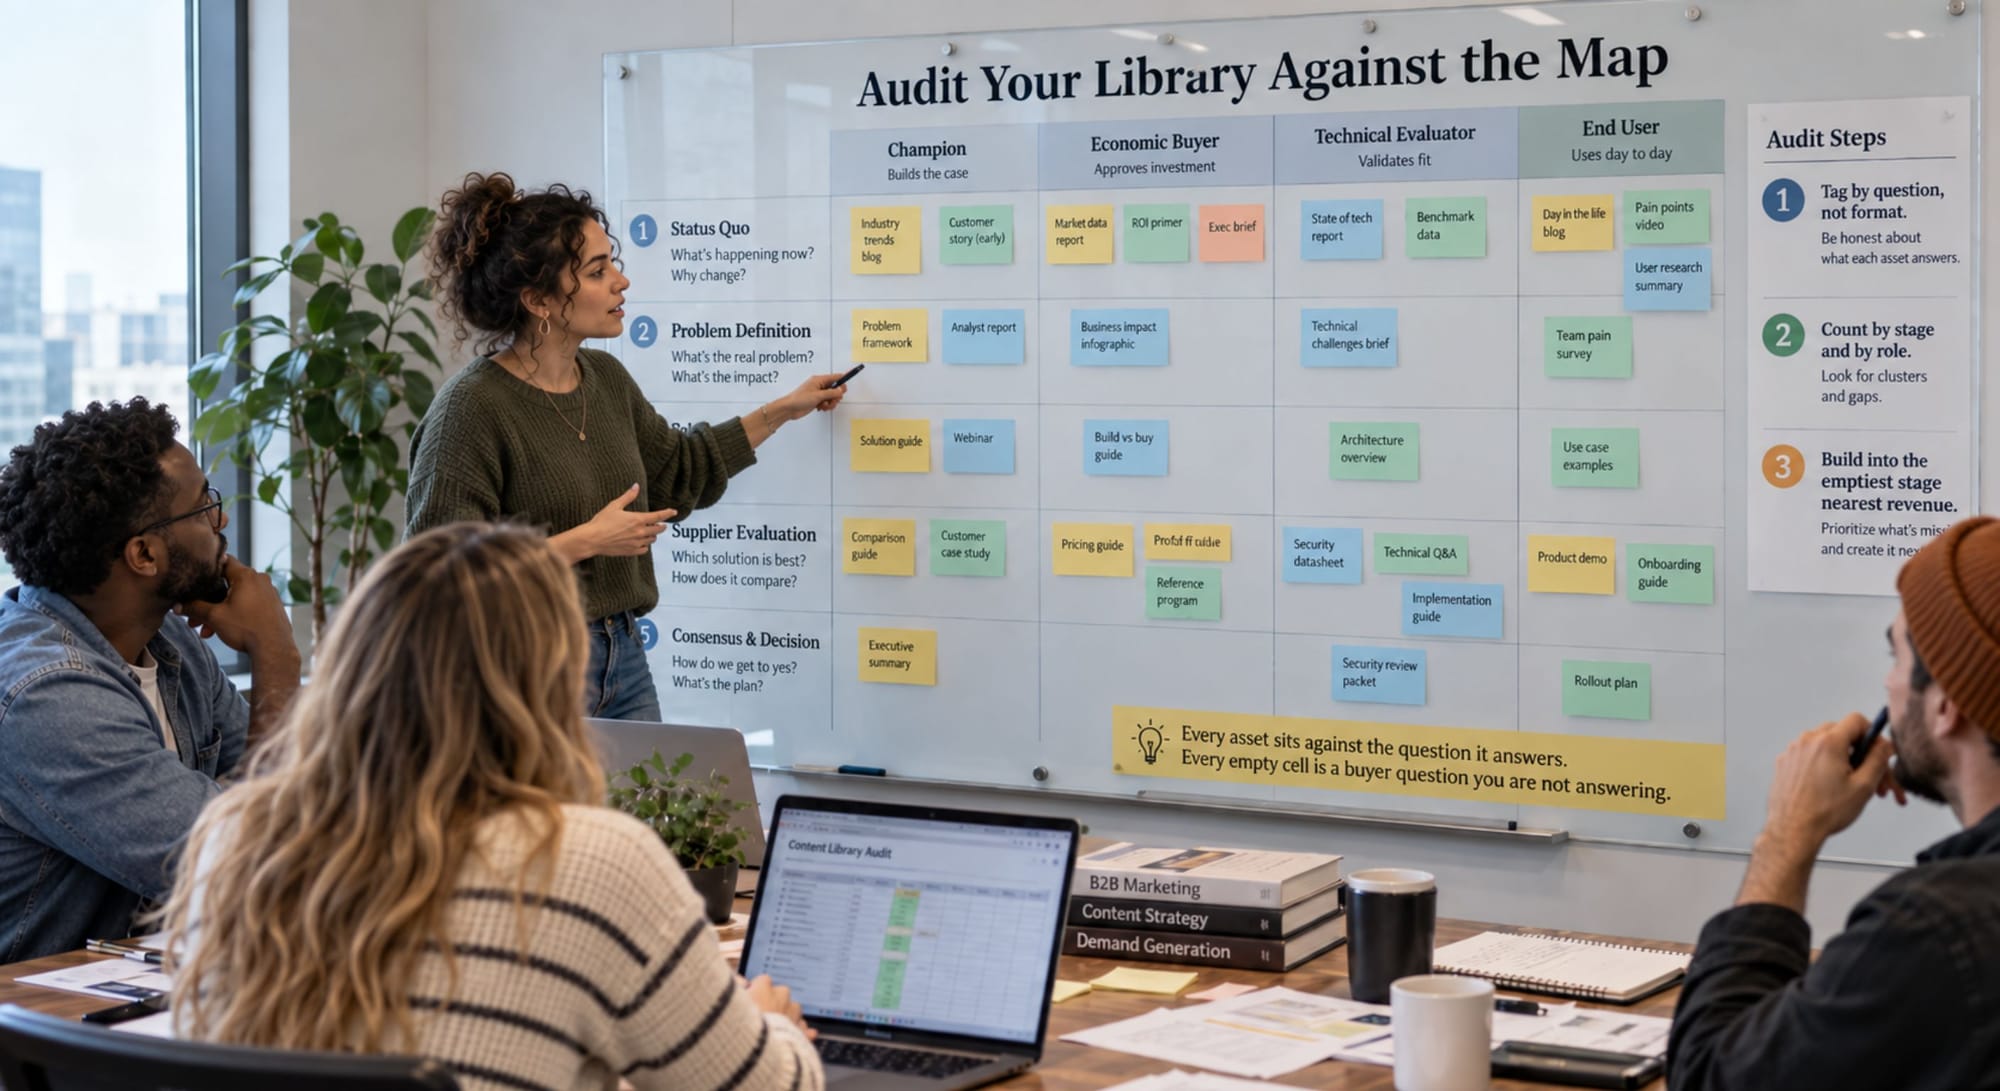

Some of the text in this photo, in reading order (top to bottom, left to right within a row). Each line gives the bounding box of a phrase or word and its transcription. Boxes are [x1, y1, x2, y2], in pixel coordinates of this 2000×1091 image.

[856, 36, 1668, 107] Audit Your Library Against the Map
[1314, 124, 1476, 144] Technical Evaluator
[1583, 118, 1660, 136] End User
[1091, 133, 1220, 153] Economic Buyer
[1766, 128, 1886, 152] Audit Steps
[887, 140, 966, 160] Champion
[1358, 152, 1431, 167] Validates fit
[887, 166, 969, 181] Builds the case
[1094, 161, 1215, 178] Approves investment
[1820, 181, 1944, 202] Tag by question,
[1776, 188, 1790, 211] 1
[1635, 201, 1694, 216] Pain points
[1821, 203, 1907, 220] not format.
[861, 217, 900, 231] Industry
[948, 217, 994, 228] Customer
[1131, 217, 1183, 230] ROI primer
[1417, 210, 1474, 223] Benchmark
[638, 221, 648, 240] 1
[671, 220, 750, 239] Status Quo
[1208, 220, 1256, 232] Exec brief
[1635, 219, 1664, 230] video
[864, 234, 894, 246] trends
[949, 232, 1005, 246] story (early)
[1416, 229, 1441, 240] data
[1821, 231, 1921, 244] Be honest about
[670, 246, 814, 263] What's happening now?
[861, 250, 882, 264] blog
[1635, 261, 1702, 273] User research
[671, 267, 746, 285] Why change?
[1635, 282, 1683, 293] summary
[638, 322, 649, 341] 2
[672, 322, 811, 338] Problem Definition
[862, 320, 901, 332] Problem
[1081, 321, 1157, 335] Business impact
[1821, 321, 1934, 340] Count by stage
[862, 336, 912, 348] framework
[1775, 322, 1791, 347] 2
[1081, 337, 1135, 352] infographic
[1821, 343, 1911, 361] and by role.
[671, 349, 814, 366] What's the real problem?
[860, 435, 923, 449] Solution guide
[953, 432, 993, 443] Webinar
[1340, 433, 1404, 446] Architecture
[1563, 441, 1609, 453] Use case
[1340, 451, 1387, 463] overview
[1822, 451, 1928, 468] Build into the
[1563, 459, 1613, 474] examples
[1775, 454, 1790, 479] 3
[1821, 473, 1942, 494] emptiest stage
[1821, 497, 1957, 512] nearest revenue.
[670, 522, 816, 543] Supplier Evaluation
[851, 531, 905, 545] Comparison
[1293, 538, 1335, 553] Security
[1383, 546, 1457, 560] Technical Q&A
[671, 550, 806, 567] Which solution is best?
[851, 548, 878, 562] guide
[1293, 555, 1344, 568] datasheet
[1537, 550, 1608, 564] Product demo
[1637, 557, 1701, 574] Onboarding
[1156, 576, 1204, 589] Reference
[1638, 576, 1668, 590] guide
[1156, 596, 1198, 608] program
[1412, 592, 1492, 606] Implementation
[1412, 610, 1441, 624] guide
[672, 627, 820, 649] Consensus & Decision
[868, 639, 914, 652] Executive
[868, 658, 911, 671] summary
[1342, 657, 1418, 673] Security review
[1342, 675, 1376, 688] packet
[1574, 674, 1638, 691] Rollout plan
[1182, 724, 1567, 767] Every asset sits against the question it answers.
[1182, 748, 1671, 805] Every empty cell is a buyer question you are not answering.
[788, 839, 892, 859] Content Library Audit
[1090, 875, 1201, 900] B2B Marketing
[1082, 903, 1208, 930] Content Strategy
[1077, 932, 1231, 959] Demand Generation
